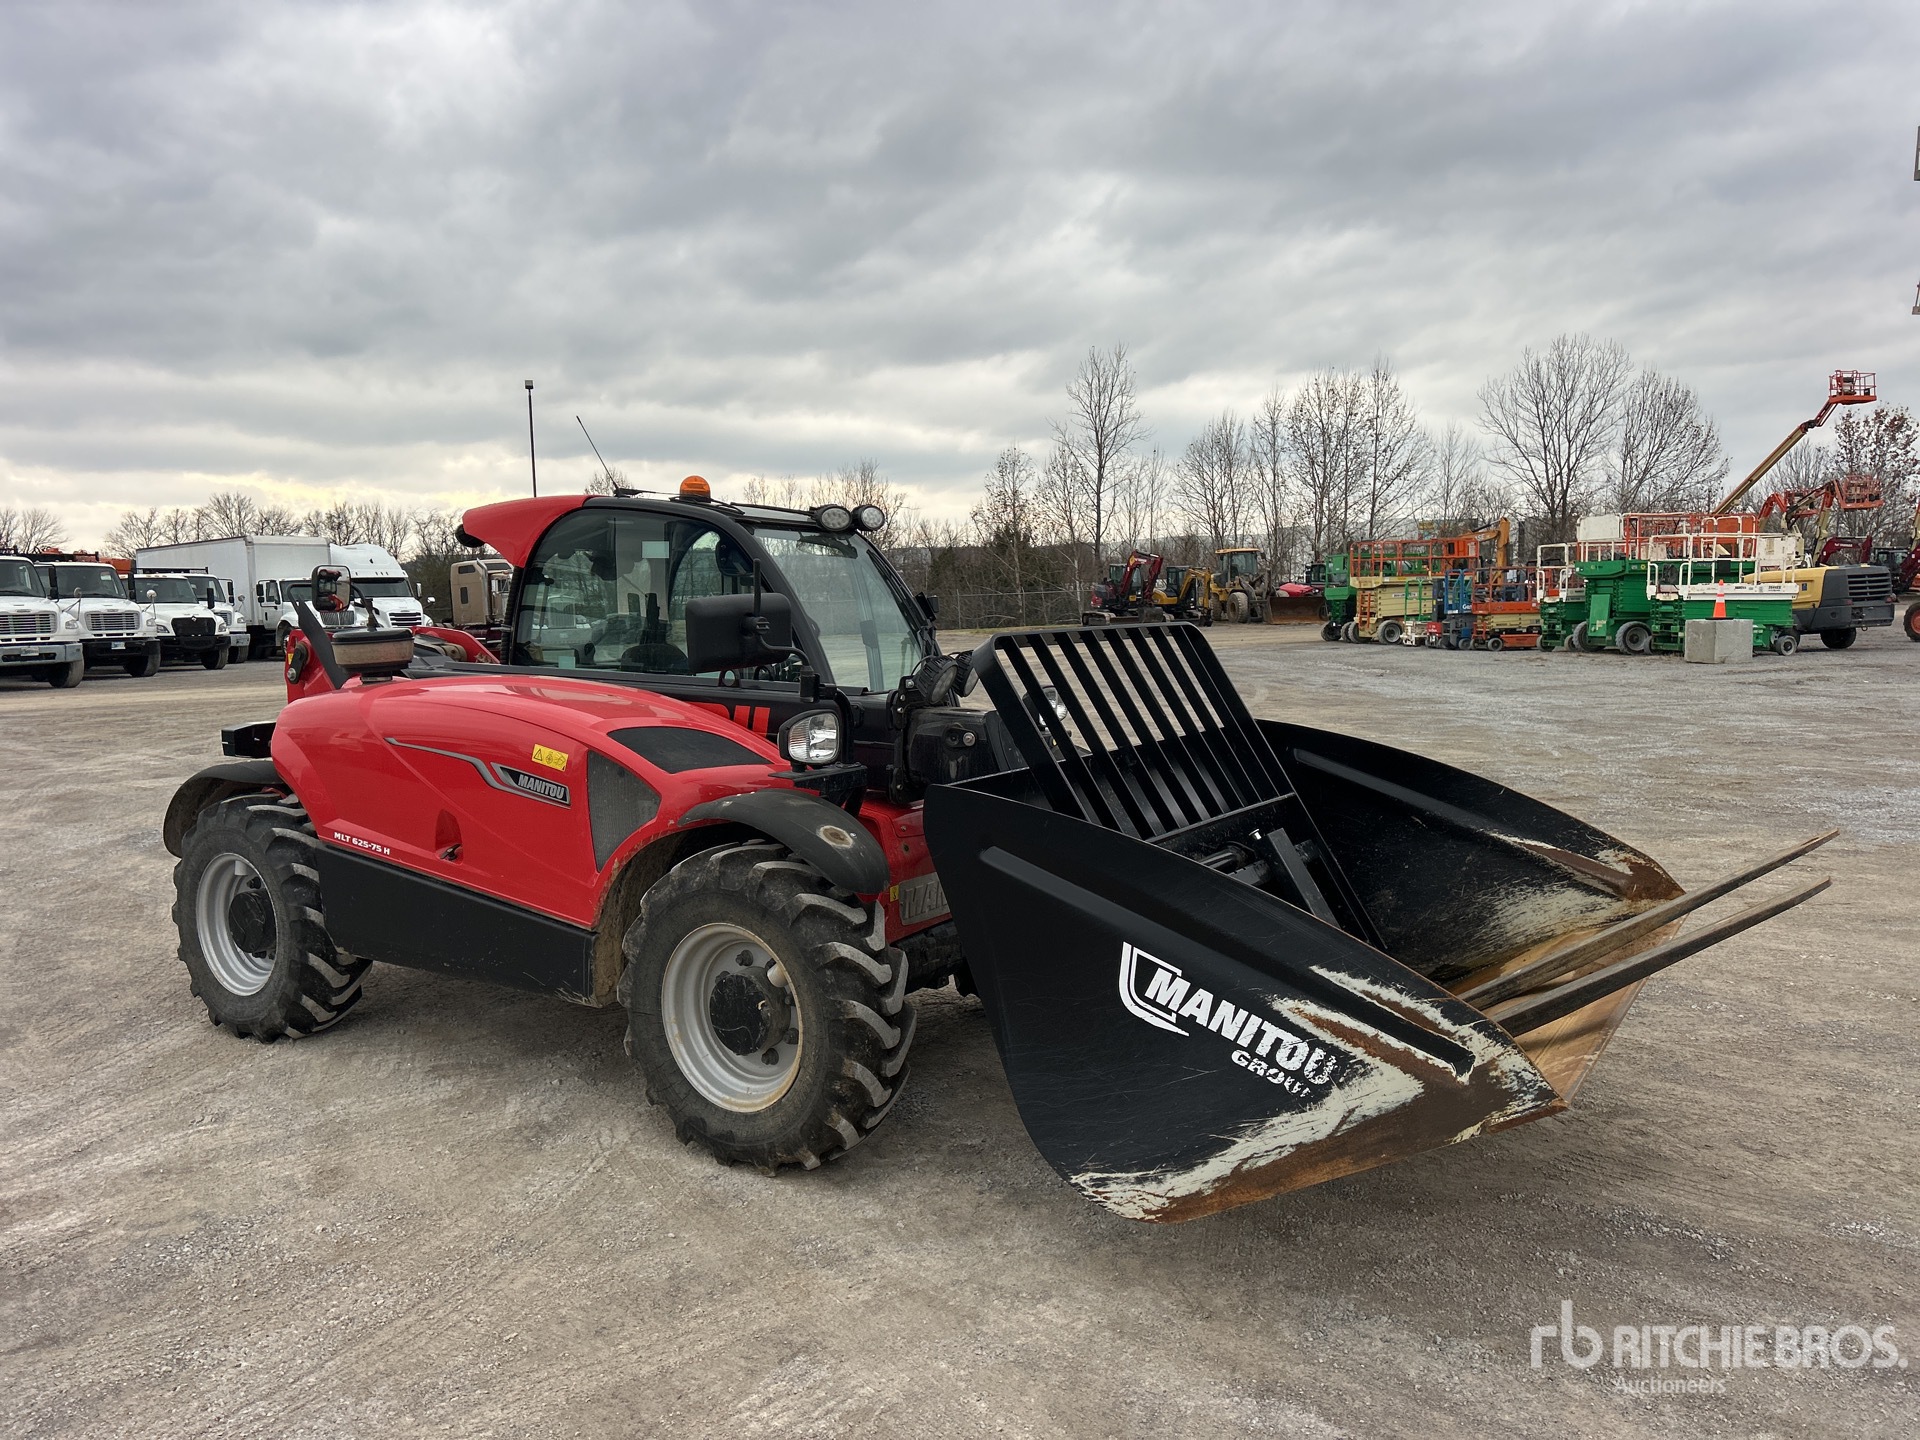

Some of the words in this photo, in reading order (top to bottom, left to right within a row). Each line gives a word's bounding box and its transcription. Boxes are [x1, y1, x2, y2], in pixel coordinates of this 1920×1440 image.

[518, 774, 565, 799] MANITOU
[333, 832, 351, 843] MLT
[352, 837, 382, 853] 625-75
[383, 847, 391, 856] H
[1144, 967, 1337, 1085] MANITOU
